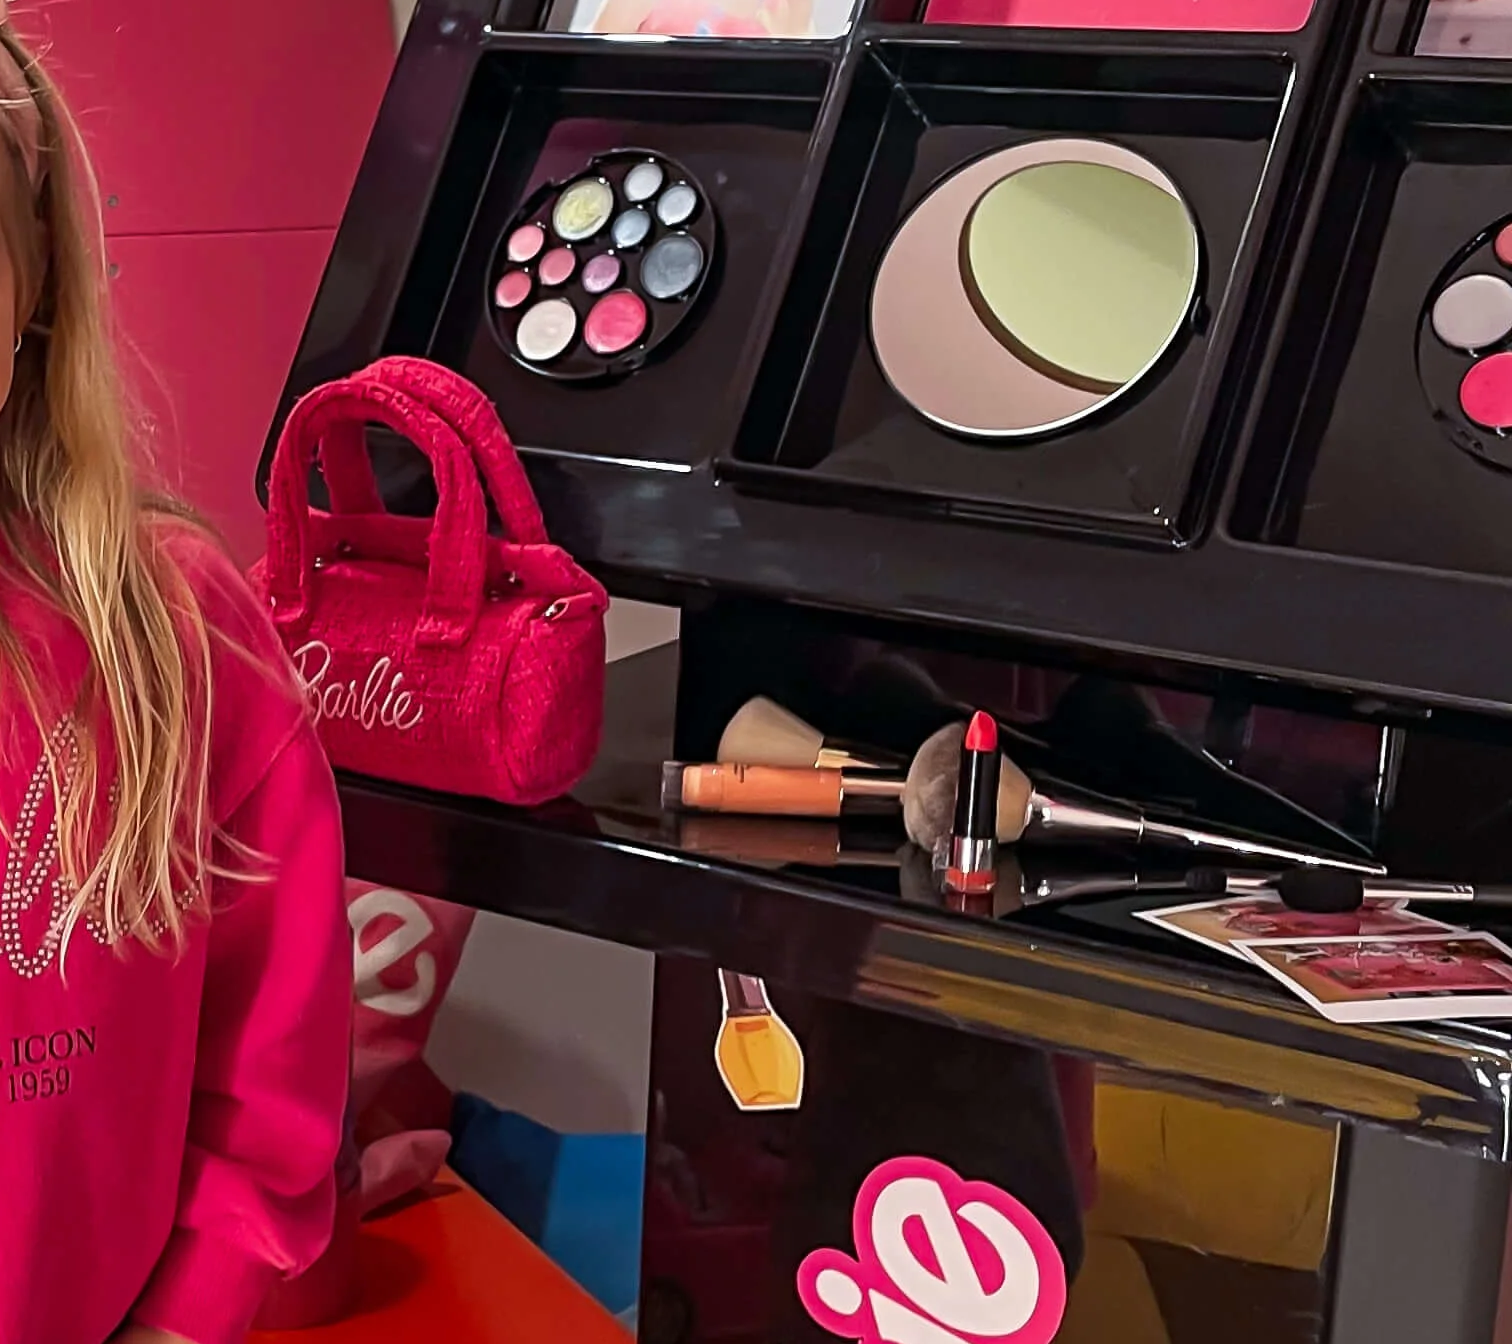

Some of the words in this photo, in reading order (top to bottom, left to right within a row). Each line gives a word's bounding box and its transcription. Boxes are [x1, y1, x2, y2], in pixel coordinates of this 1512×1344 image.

[293, 640, 423, 730] Barbie
[13, 1027, 96, 1067] ICON
[9, 1067, 70, 1102] 1959
